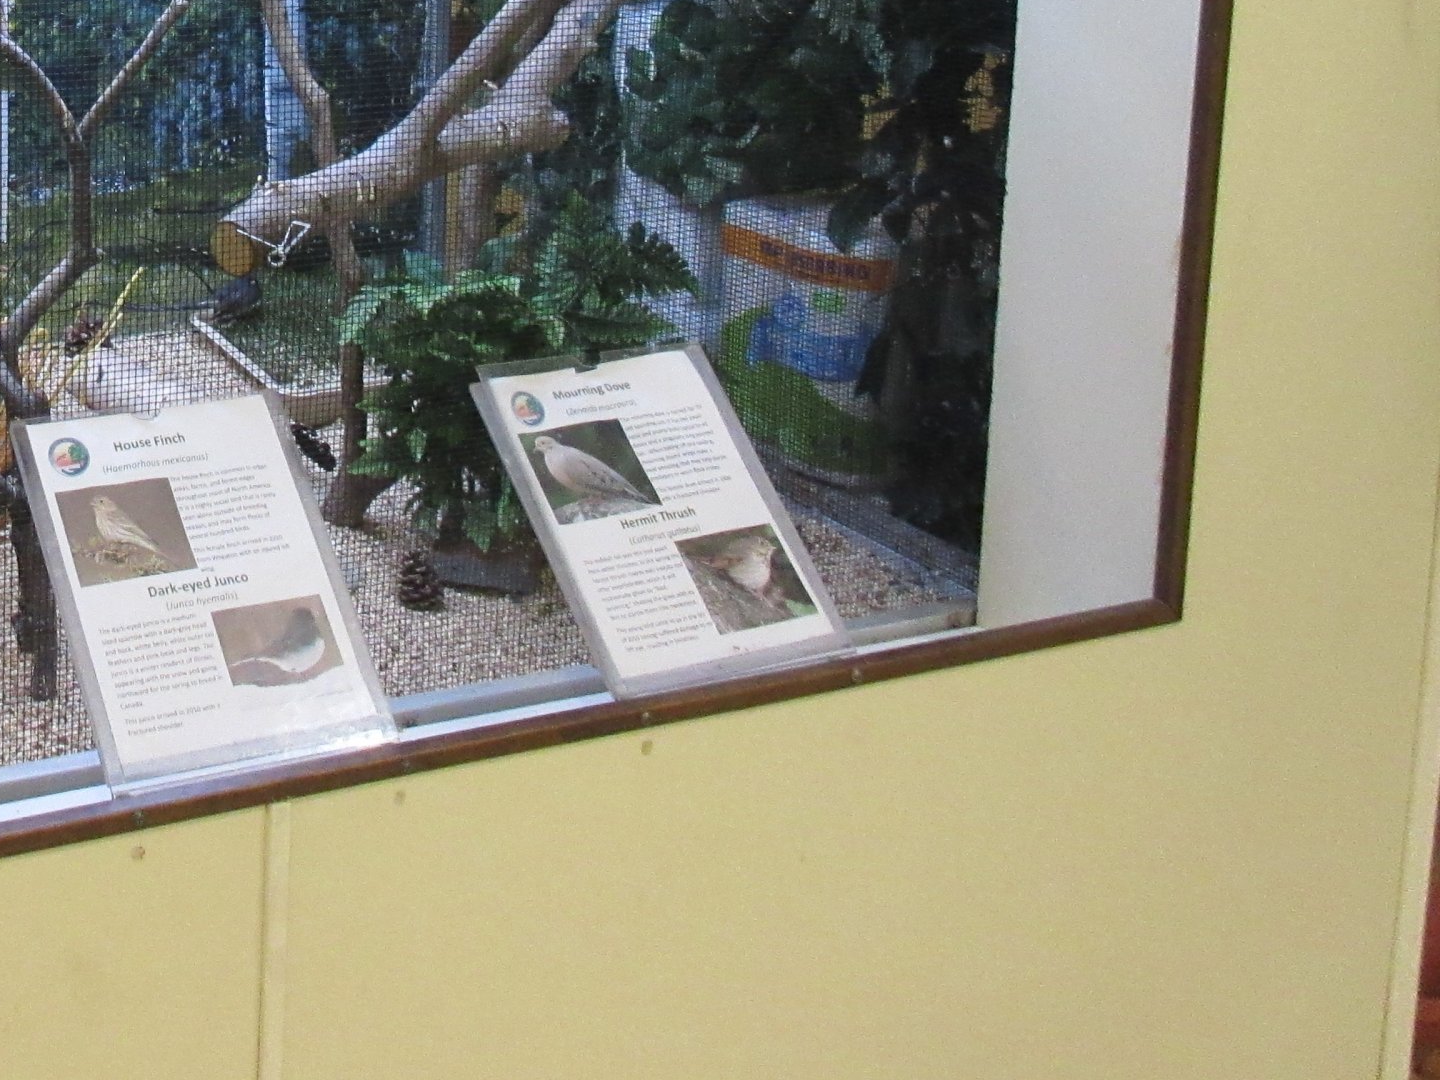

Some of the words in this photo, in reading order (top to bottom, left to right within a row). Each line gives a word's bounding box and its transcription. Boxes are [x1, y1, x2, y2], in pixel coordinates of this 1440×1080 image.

[551, 386, 605, 399] Mourning
[603, 382, 631, 392] Dove
[112, 439, 152, 451] House
[153, 433, 186, 445] Finch
[618, 513, 658, 528] Hermit
[658, 506, 697, 521] Thrush
[147, 577, 211, 597] Dark-eyed
[212, 573, 249, 586] Junco
[165, 599, 194, 611] (Junco
